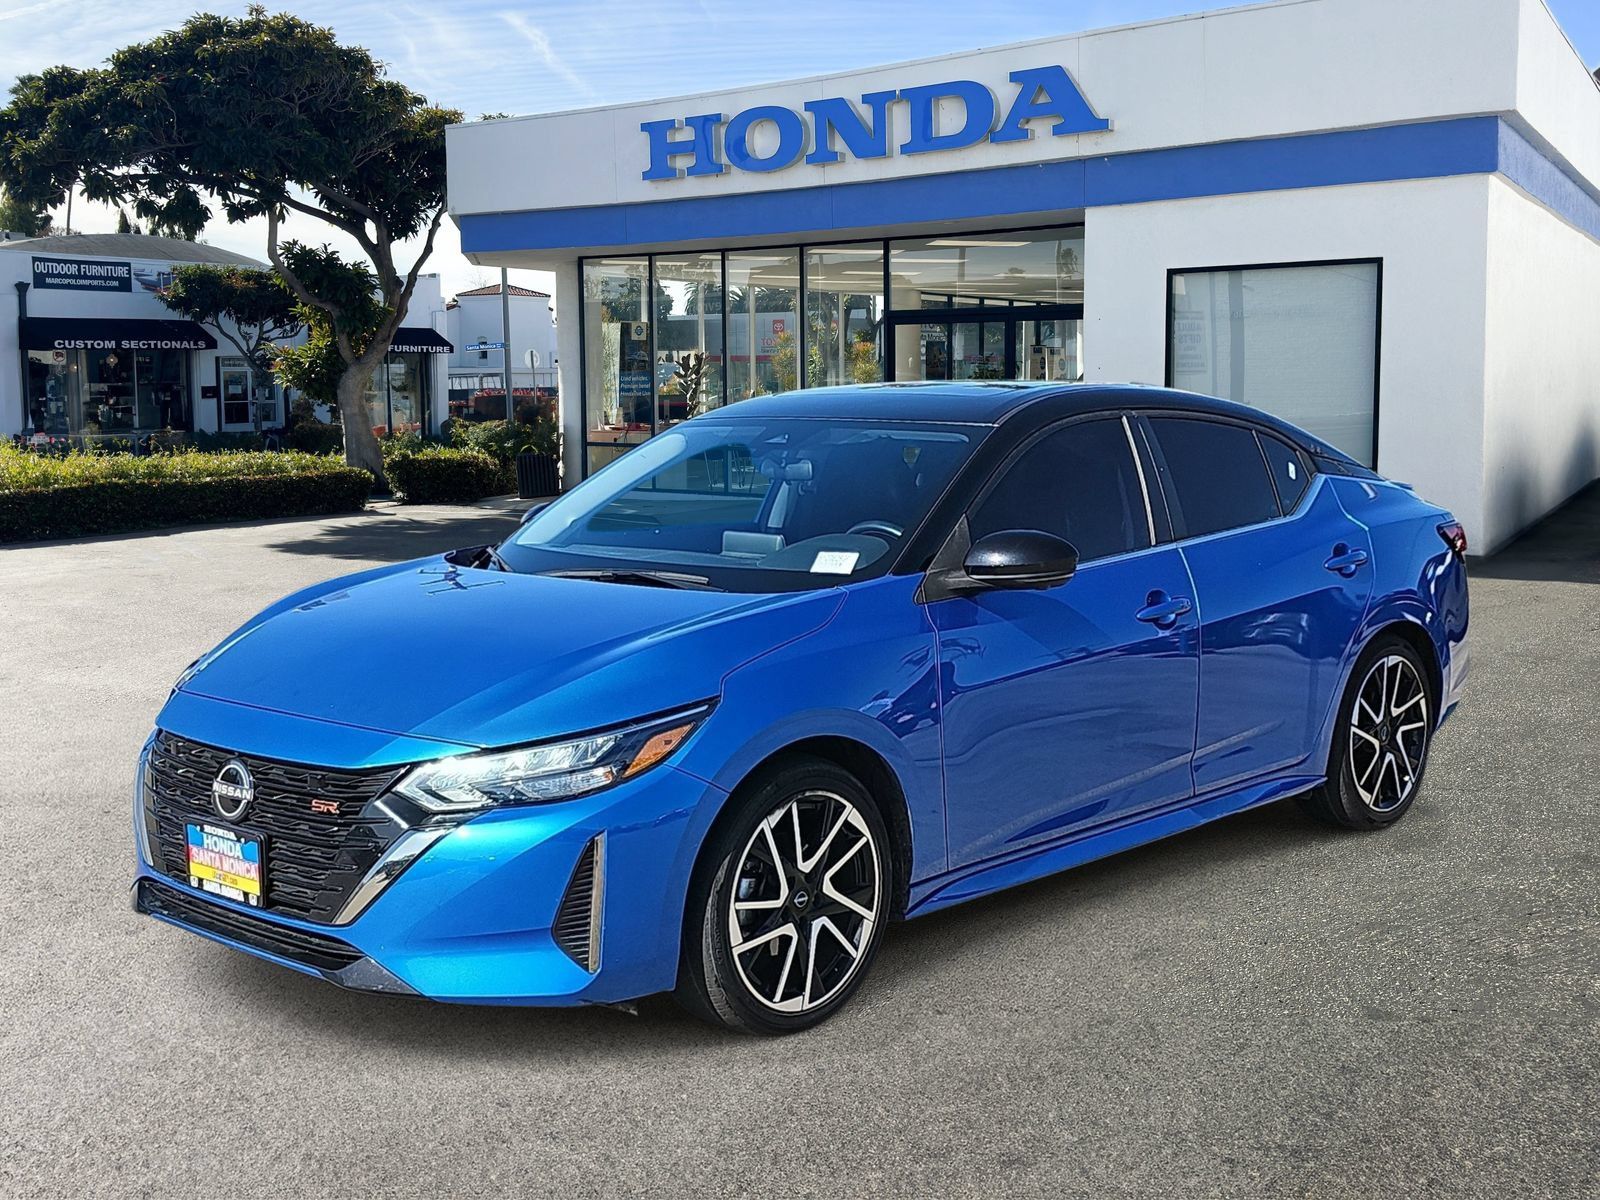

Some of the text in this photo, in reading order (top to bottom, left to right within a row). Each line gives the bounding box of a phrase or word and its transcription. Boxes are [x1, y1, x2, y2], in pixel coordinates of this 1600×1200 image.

[641, 65, 1112, 182] HONDA
[34, 261, 130, 277] OUTDOOR FURNITURE
[45, 277, 119, 287] MARCOPOLOIMPORTS.COM
[54, 340, 206, 349] CUSTOM SECTIONALS
[388, 344, 450, 353] FURNITURE
[212, 781, 252, 801] NISSAN
[311, 799, 340, 813] SR
[203, 833, 244, 860] HONDA
[191, 847, 222, 871] SANTA
[221, 854, 259, 882] MONICA
